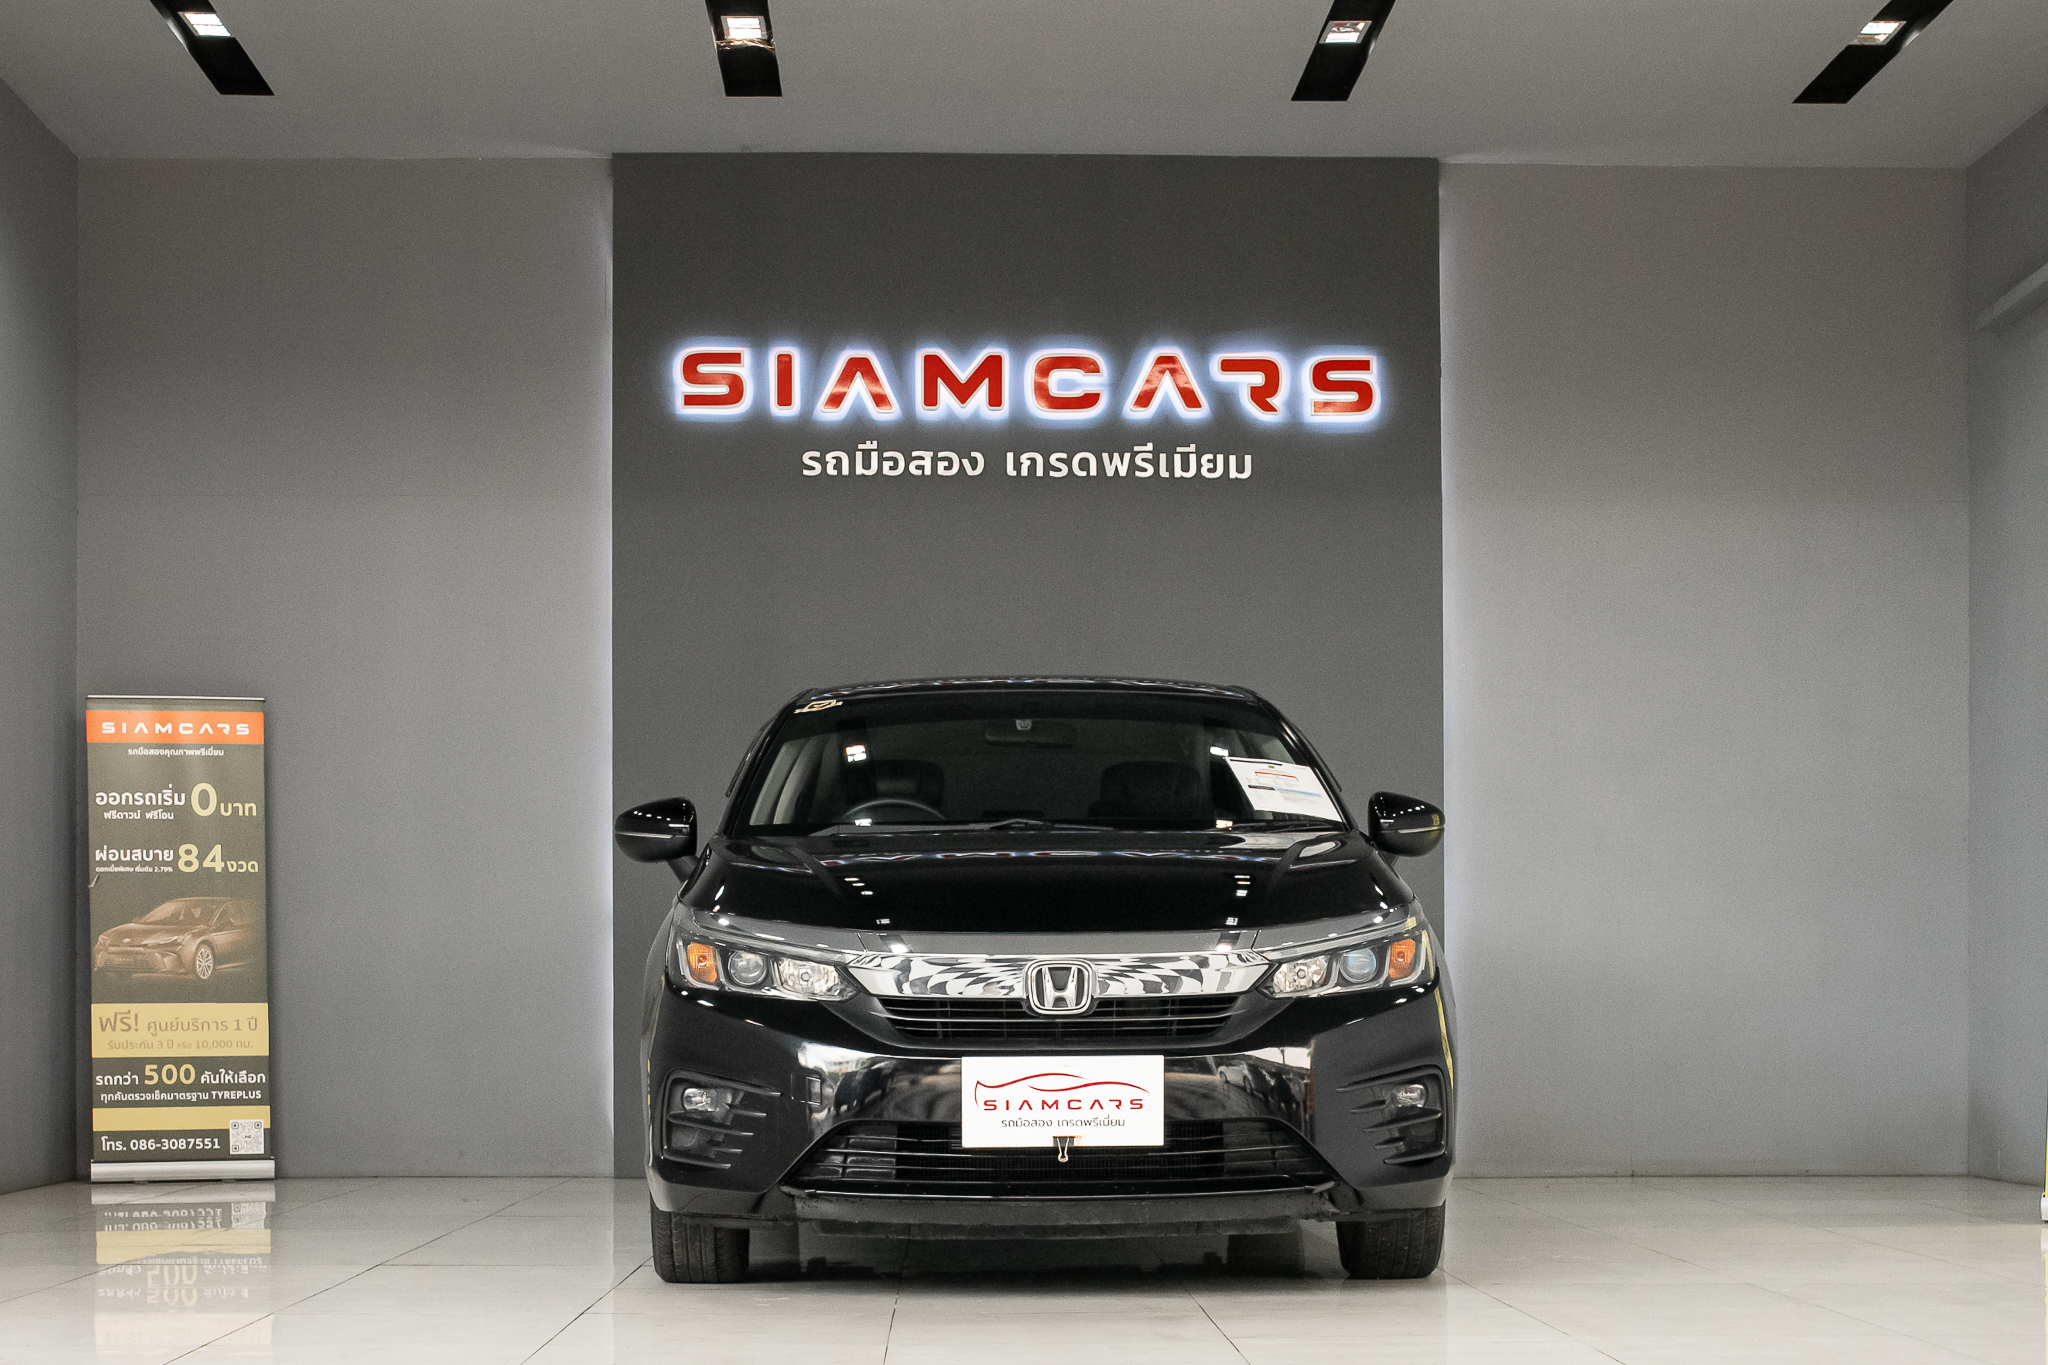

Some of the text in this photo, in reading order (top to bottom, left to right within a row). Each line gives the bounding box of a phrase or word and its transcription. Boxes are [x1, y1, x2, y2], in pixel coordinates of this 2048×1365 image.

[680, 349, 1378, 416] SIAMCARS
[801, 440, 1252, 479] รถมือสอง เกรดพรีเมียม
[101, 721, 250, 736] SIAMCARS
[95, 782, 257, 817] ออกรถเริ่ม 0 บาท
[103, 808, 174, 820] ฟรีดาวน์ ฟรีโอน
[95, 843, 259, 873] ผ่อนสบาย 84 งวด
[99, 1010, 258, 1037] ฟรี! ศูนย์บริการ 1 ปี
[107, 1039, 154, 1050] รับประกัน
[157, 1040, 164, 1050] 3
[167, 1039, 174, 1050] ปี
[95, 1063, 266, 1086] รถกว่า 500 คันให้เลือก
[211, 1090, 262, 1099] TYREPLUS
[983, 1098, 1144, 1111] SIAMCARS
[1001, 1117, 1053, 1128] รถมือสอง
[101, 1136, 221, 1151] โทร. 086-3087551
